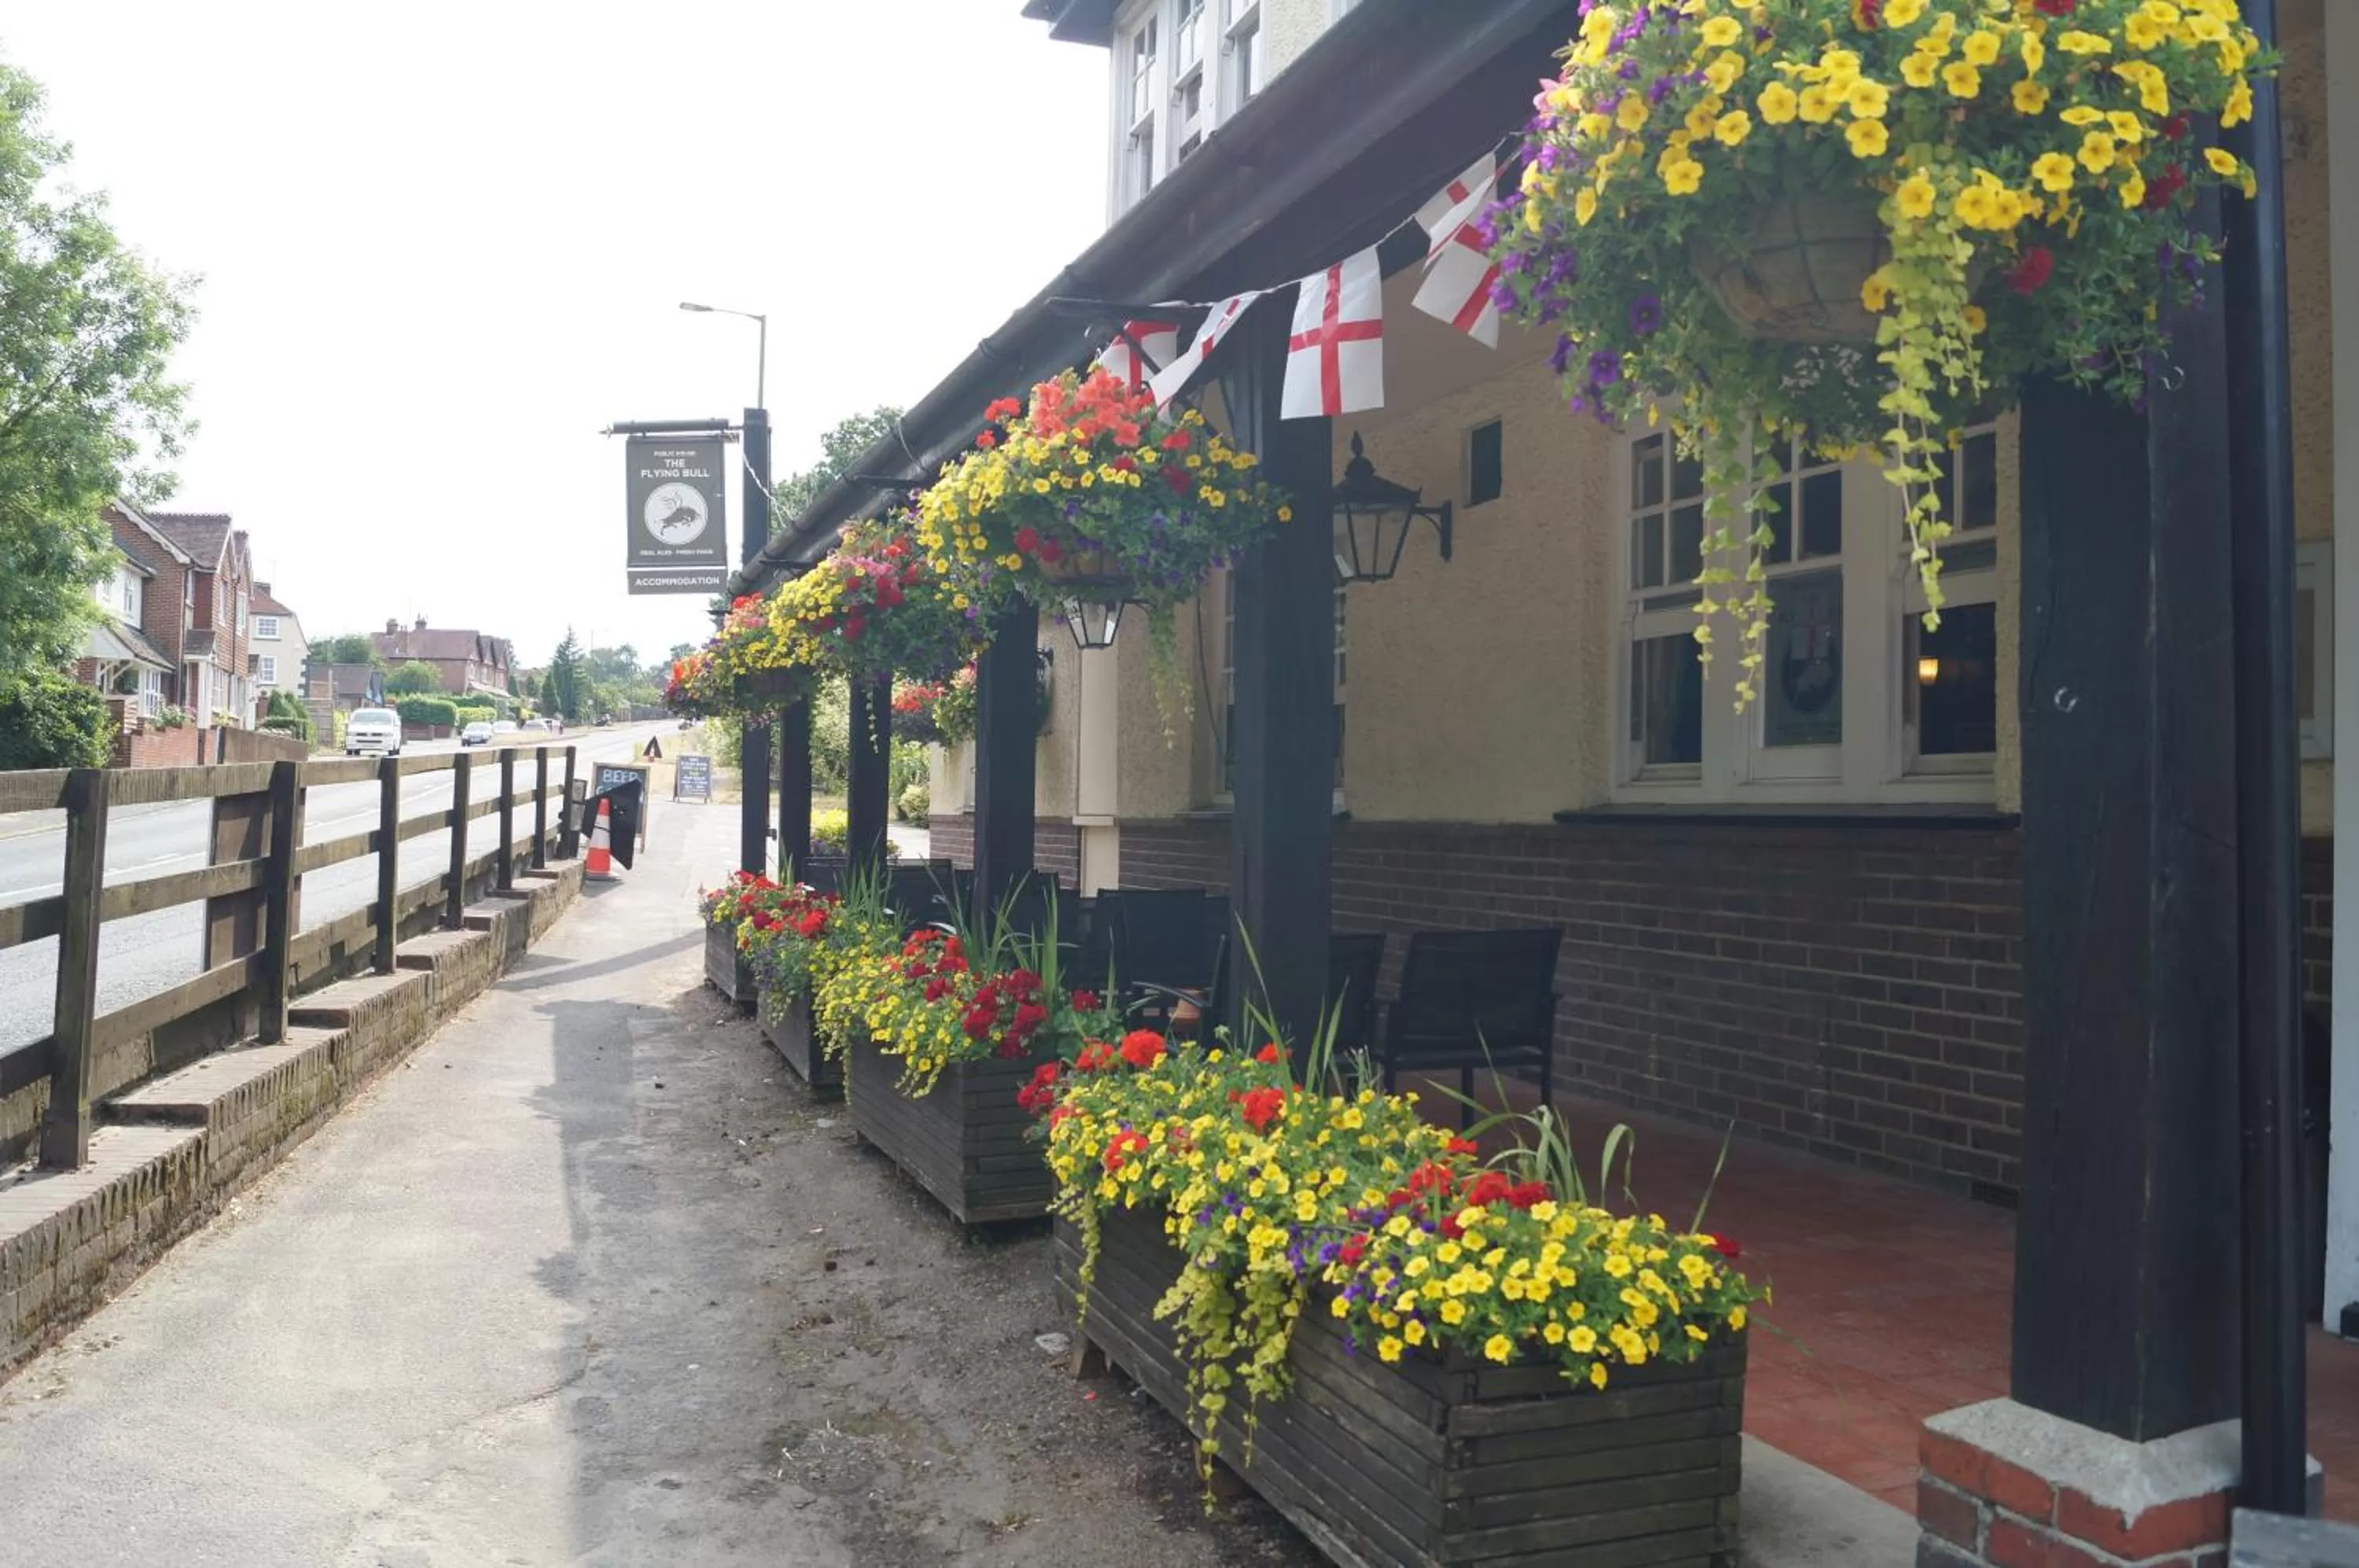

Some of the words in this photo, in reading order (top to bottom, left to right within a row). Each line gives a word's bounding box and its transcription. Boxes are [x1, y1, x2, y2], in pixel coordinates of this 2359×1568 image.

[664, 458, 686, 468] THE
[641, 469, 679, 478] FLYING
[682, 468, 710, 477] BULL
[635, 576, 719, 586] ACCOMMODATION
